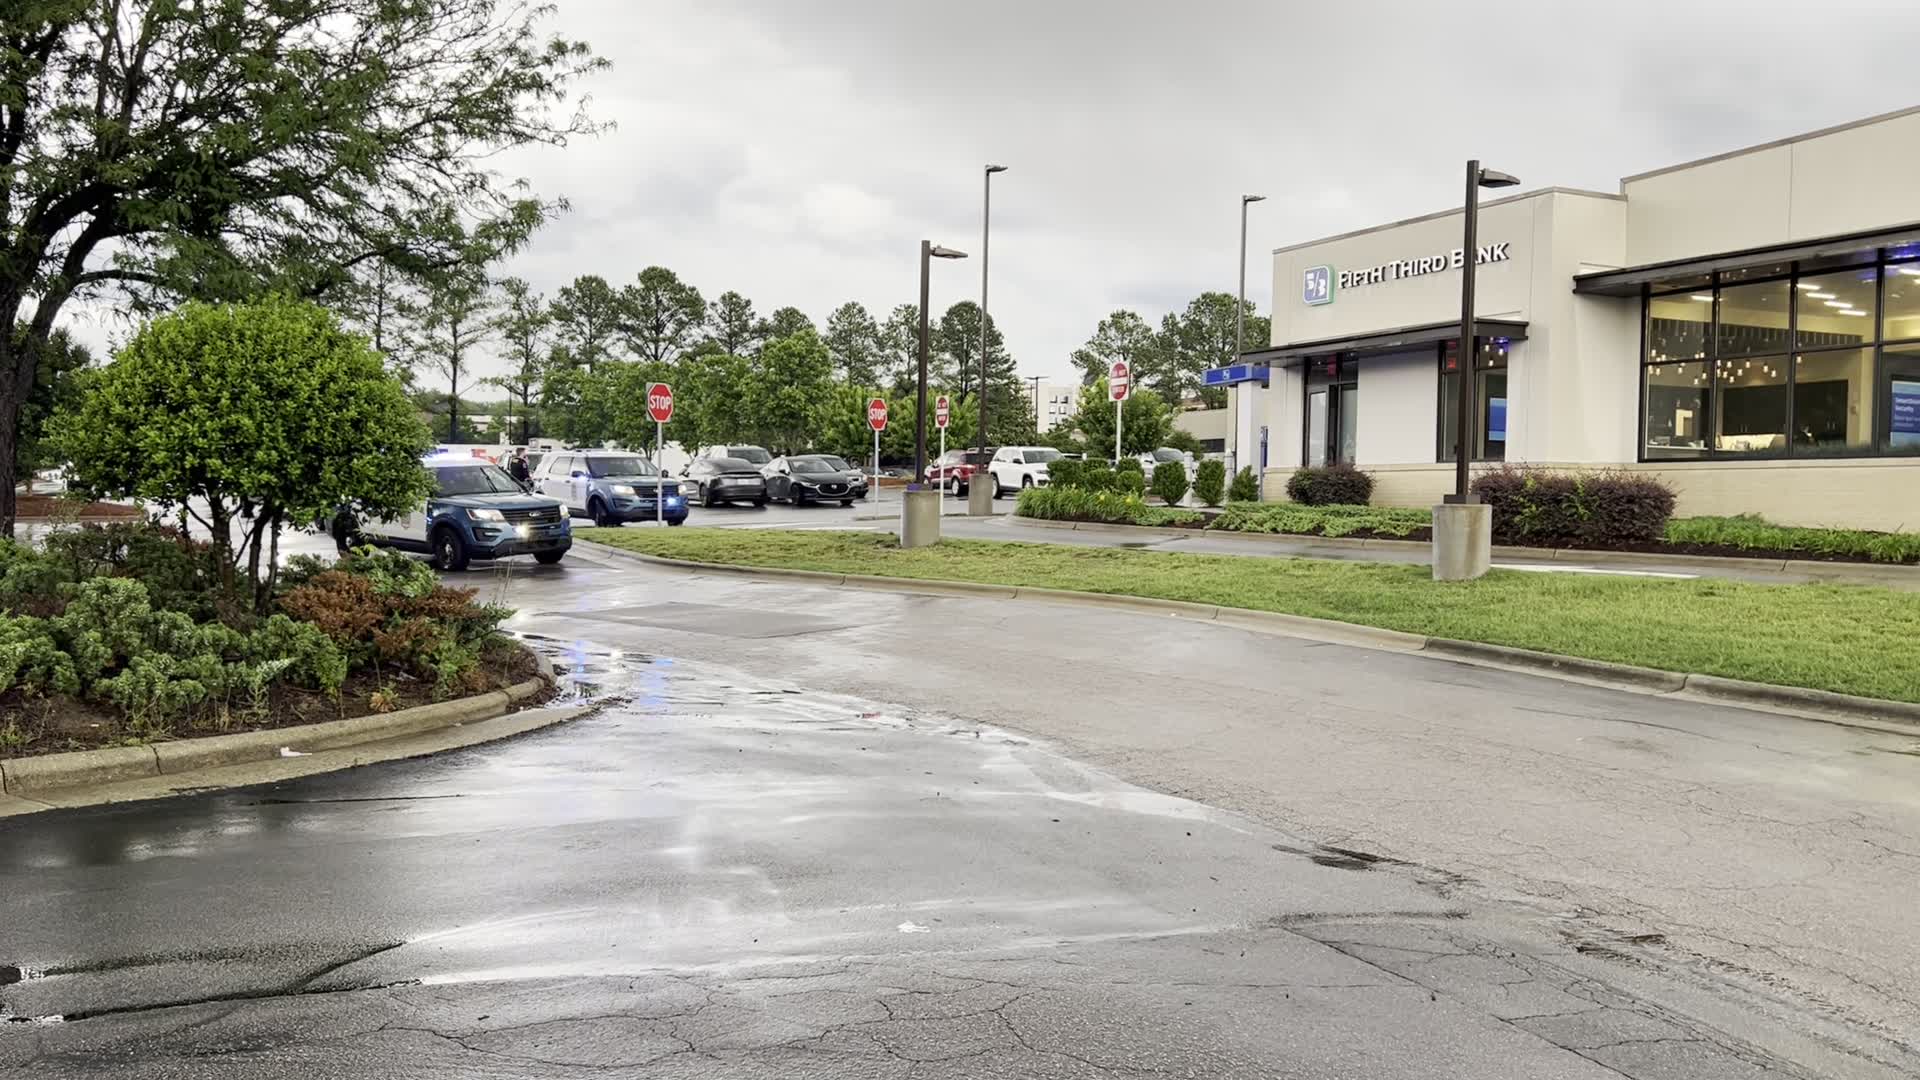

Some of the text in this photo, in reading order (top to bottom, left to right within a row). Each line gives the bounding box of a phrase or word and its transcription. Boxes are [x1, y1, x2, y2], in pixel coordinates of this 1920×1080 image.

[1338, 242, 1510, 289] FIFTH THIRD BNK
[650, 395, 671, 410] STOP
[869, 408, 887, 421] STOP
